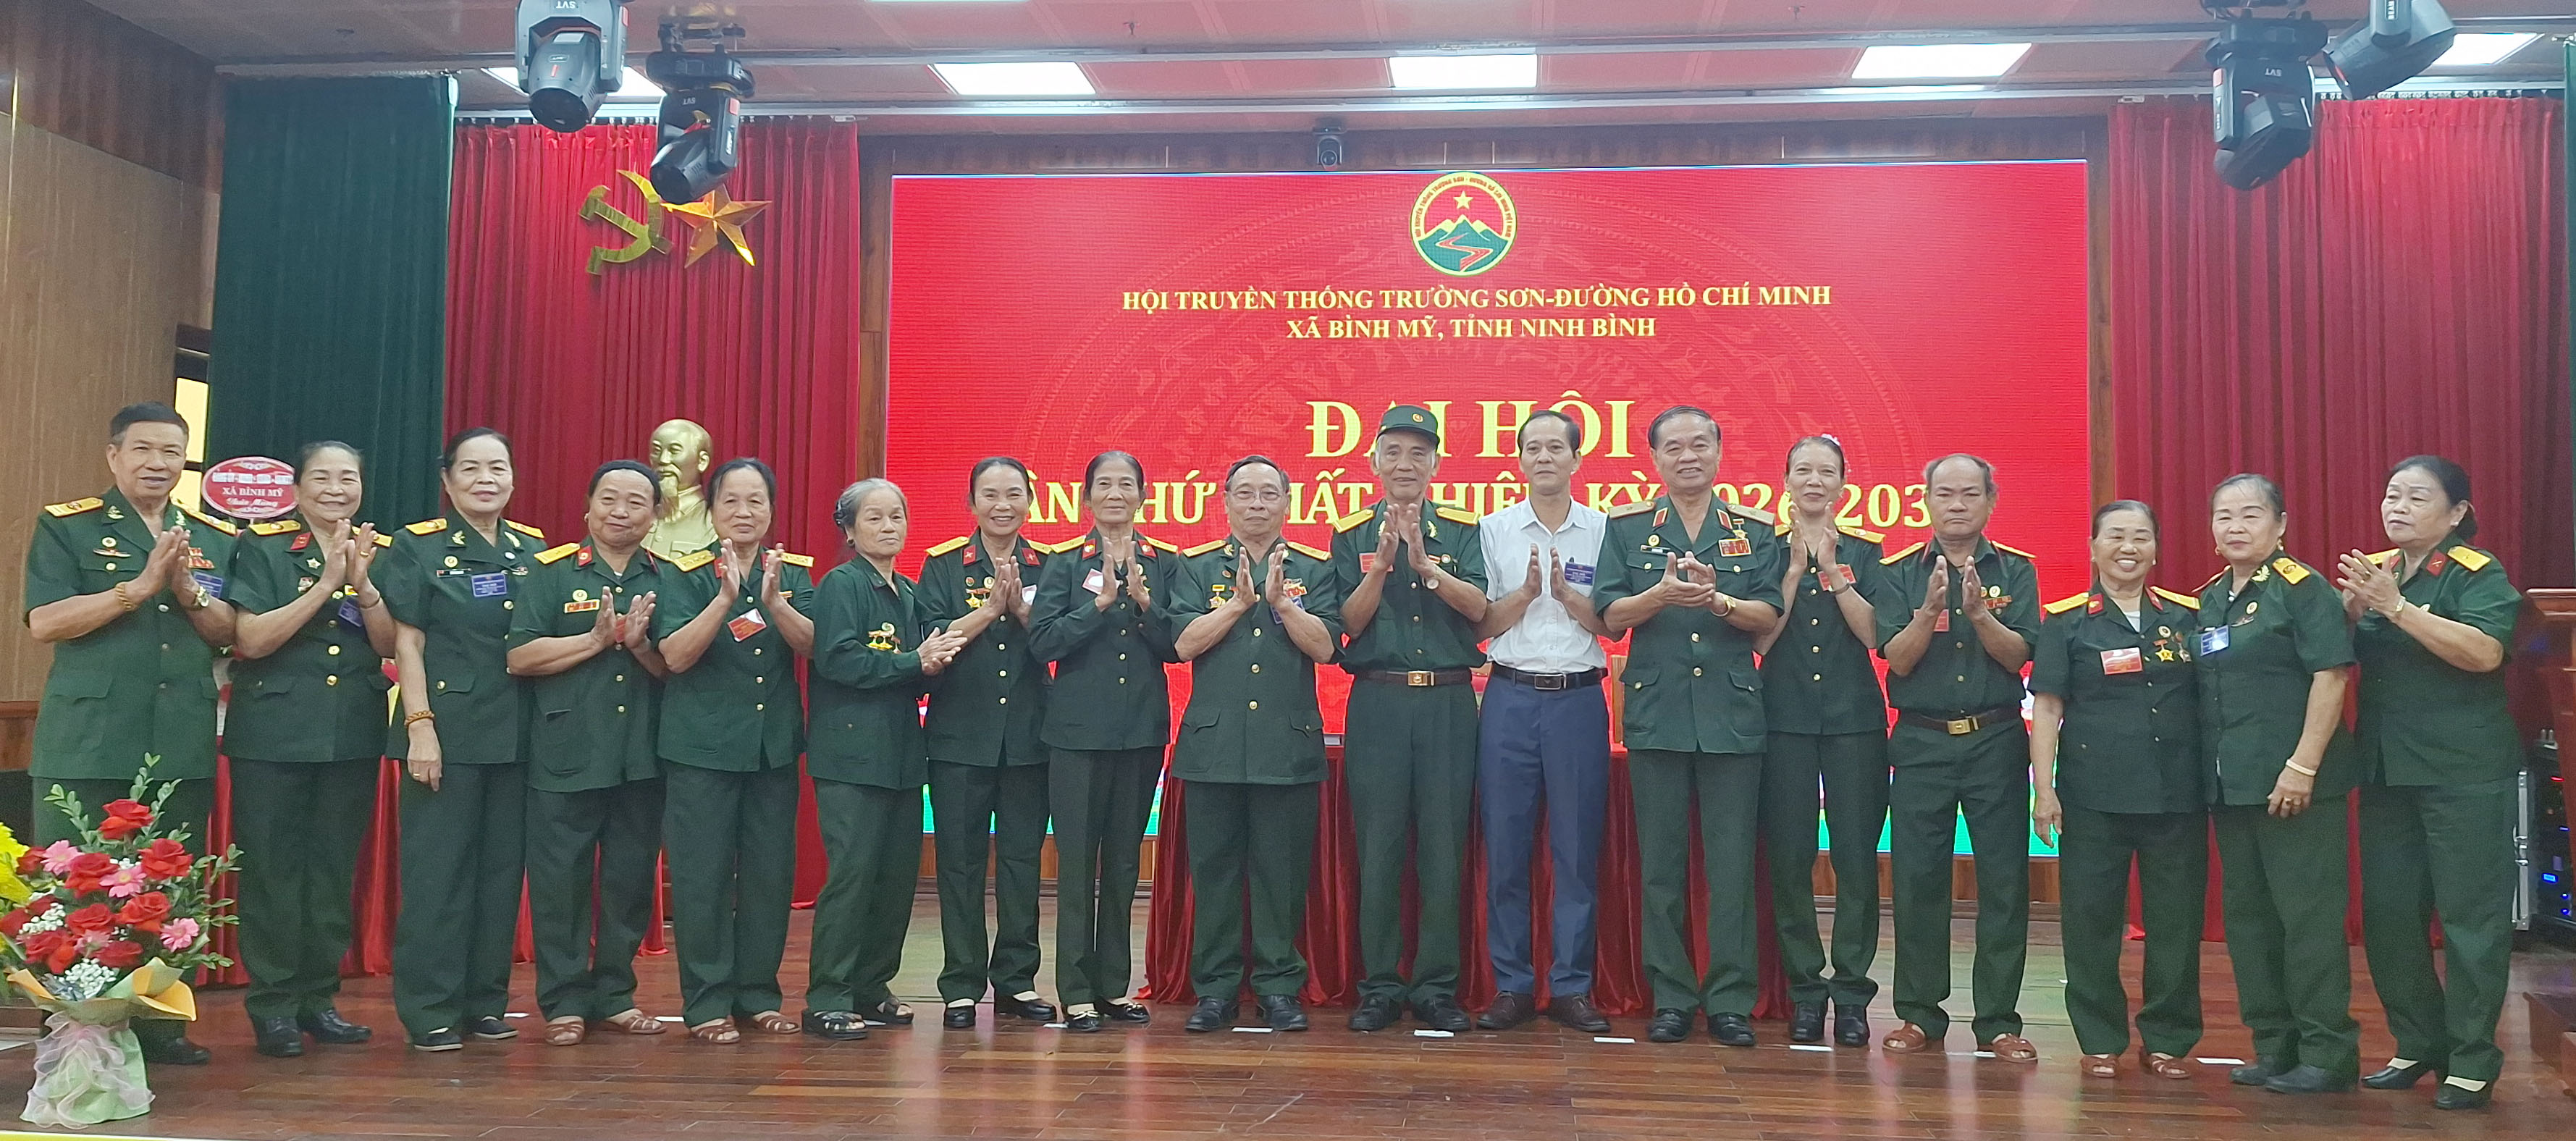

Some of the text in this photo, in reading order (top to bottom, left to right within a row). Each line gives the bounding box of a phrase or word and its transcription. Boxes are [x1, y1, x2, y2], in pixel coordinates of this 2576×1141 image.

[555, 0, 577, 9] SVT
[1123, 282, 1831, 315] HỘI TRUYỀN THỐNG TRƯỜNG SƠN-ĐƯỜNG HỒ CHÍ MINH
[1287, 313, 1657, 341] XÃ BÌNH MỸ, TỈNH NINH BÌNH
[1305, 400, 1452, 458] ĐI
[1133, 469, 1217, 524] HỨ
